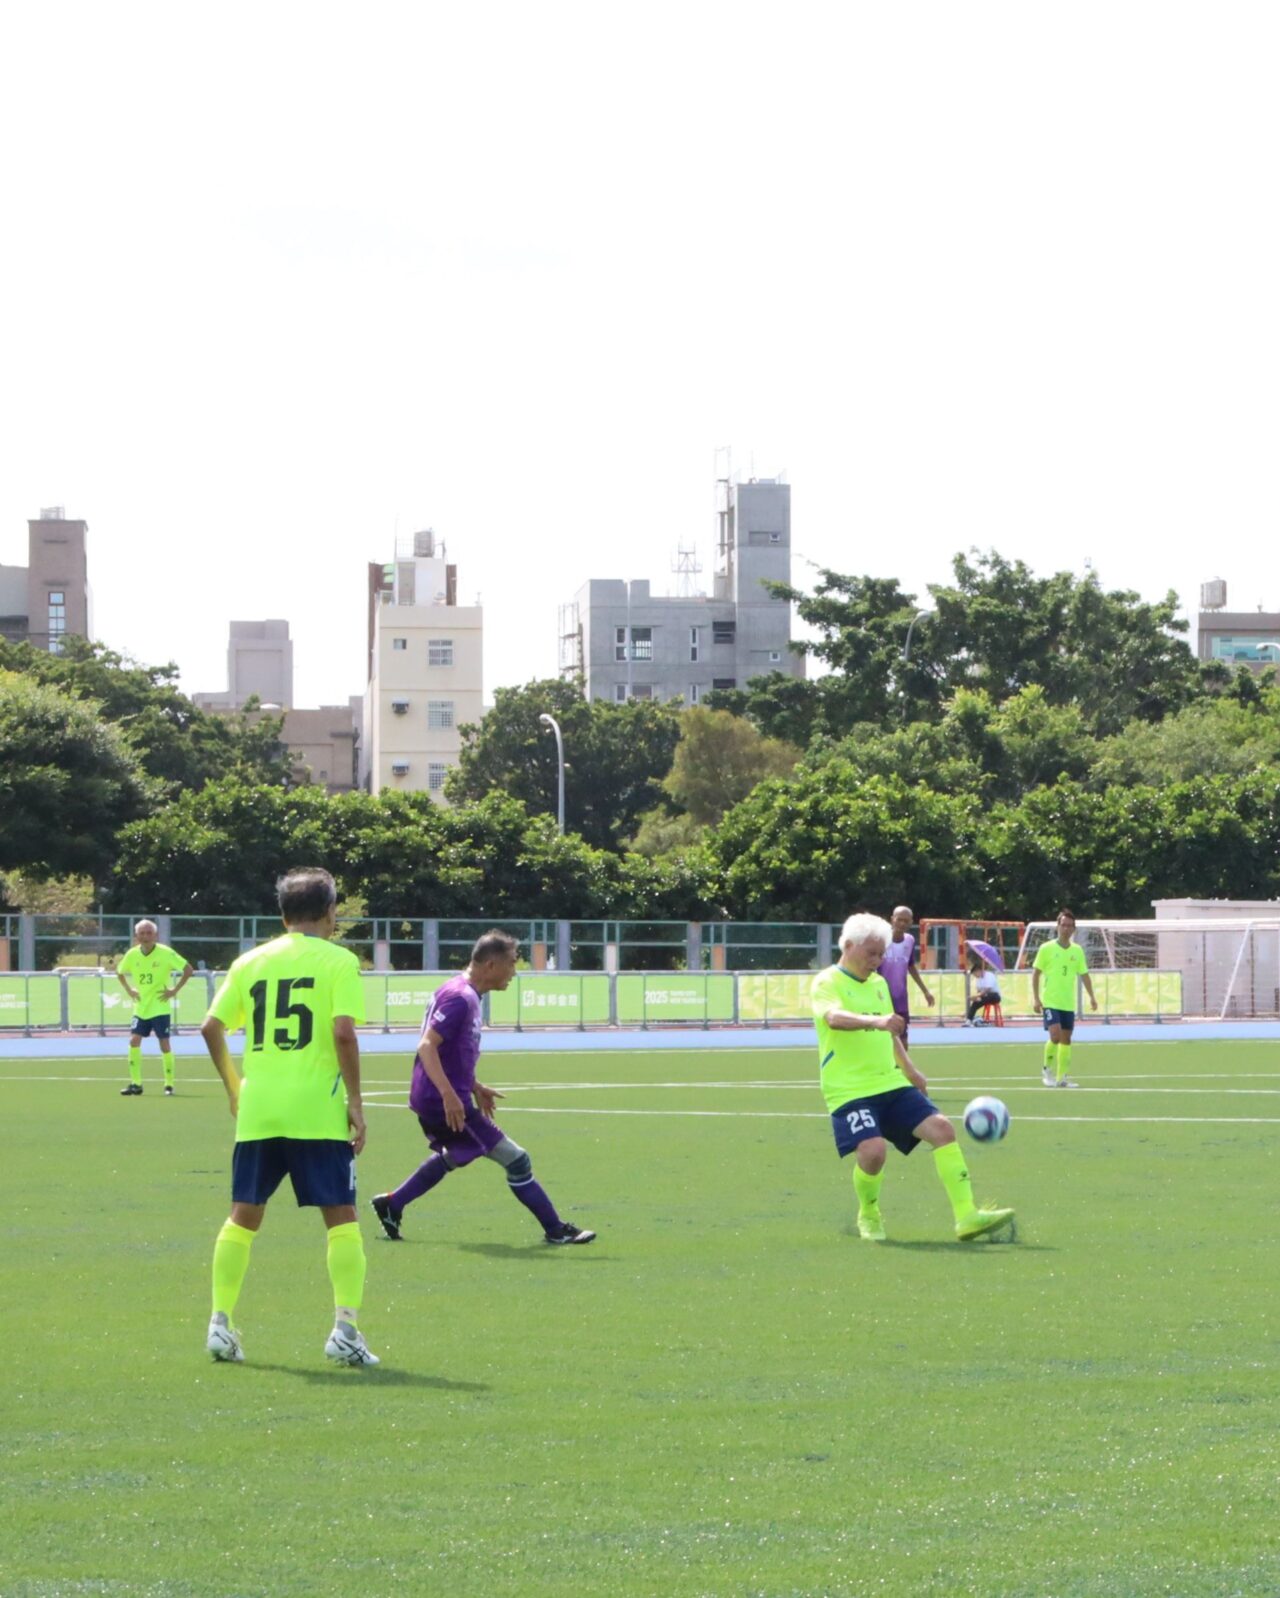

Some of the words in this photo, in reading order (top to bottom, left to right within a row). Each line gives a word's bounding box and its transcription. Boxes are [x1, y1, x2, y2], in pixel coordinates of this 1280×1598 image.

[1062, 965, 1068, 976] 3
[139, 973, 153, 985] 23
[645, 990, 668, 1005] 2025
[249, 977, 315, 1051] 15
[846, 1109, 876, 1134] 25
